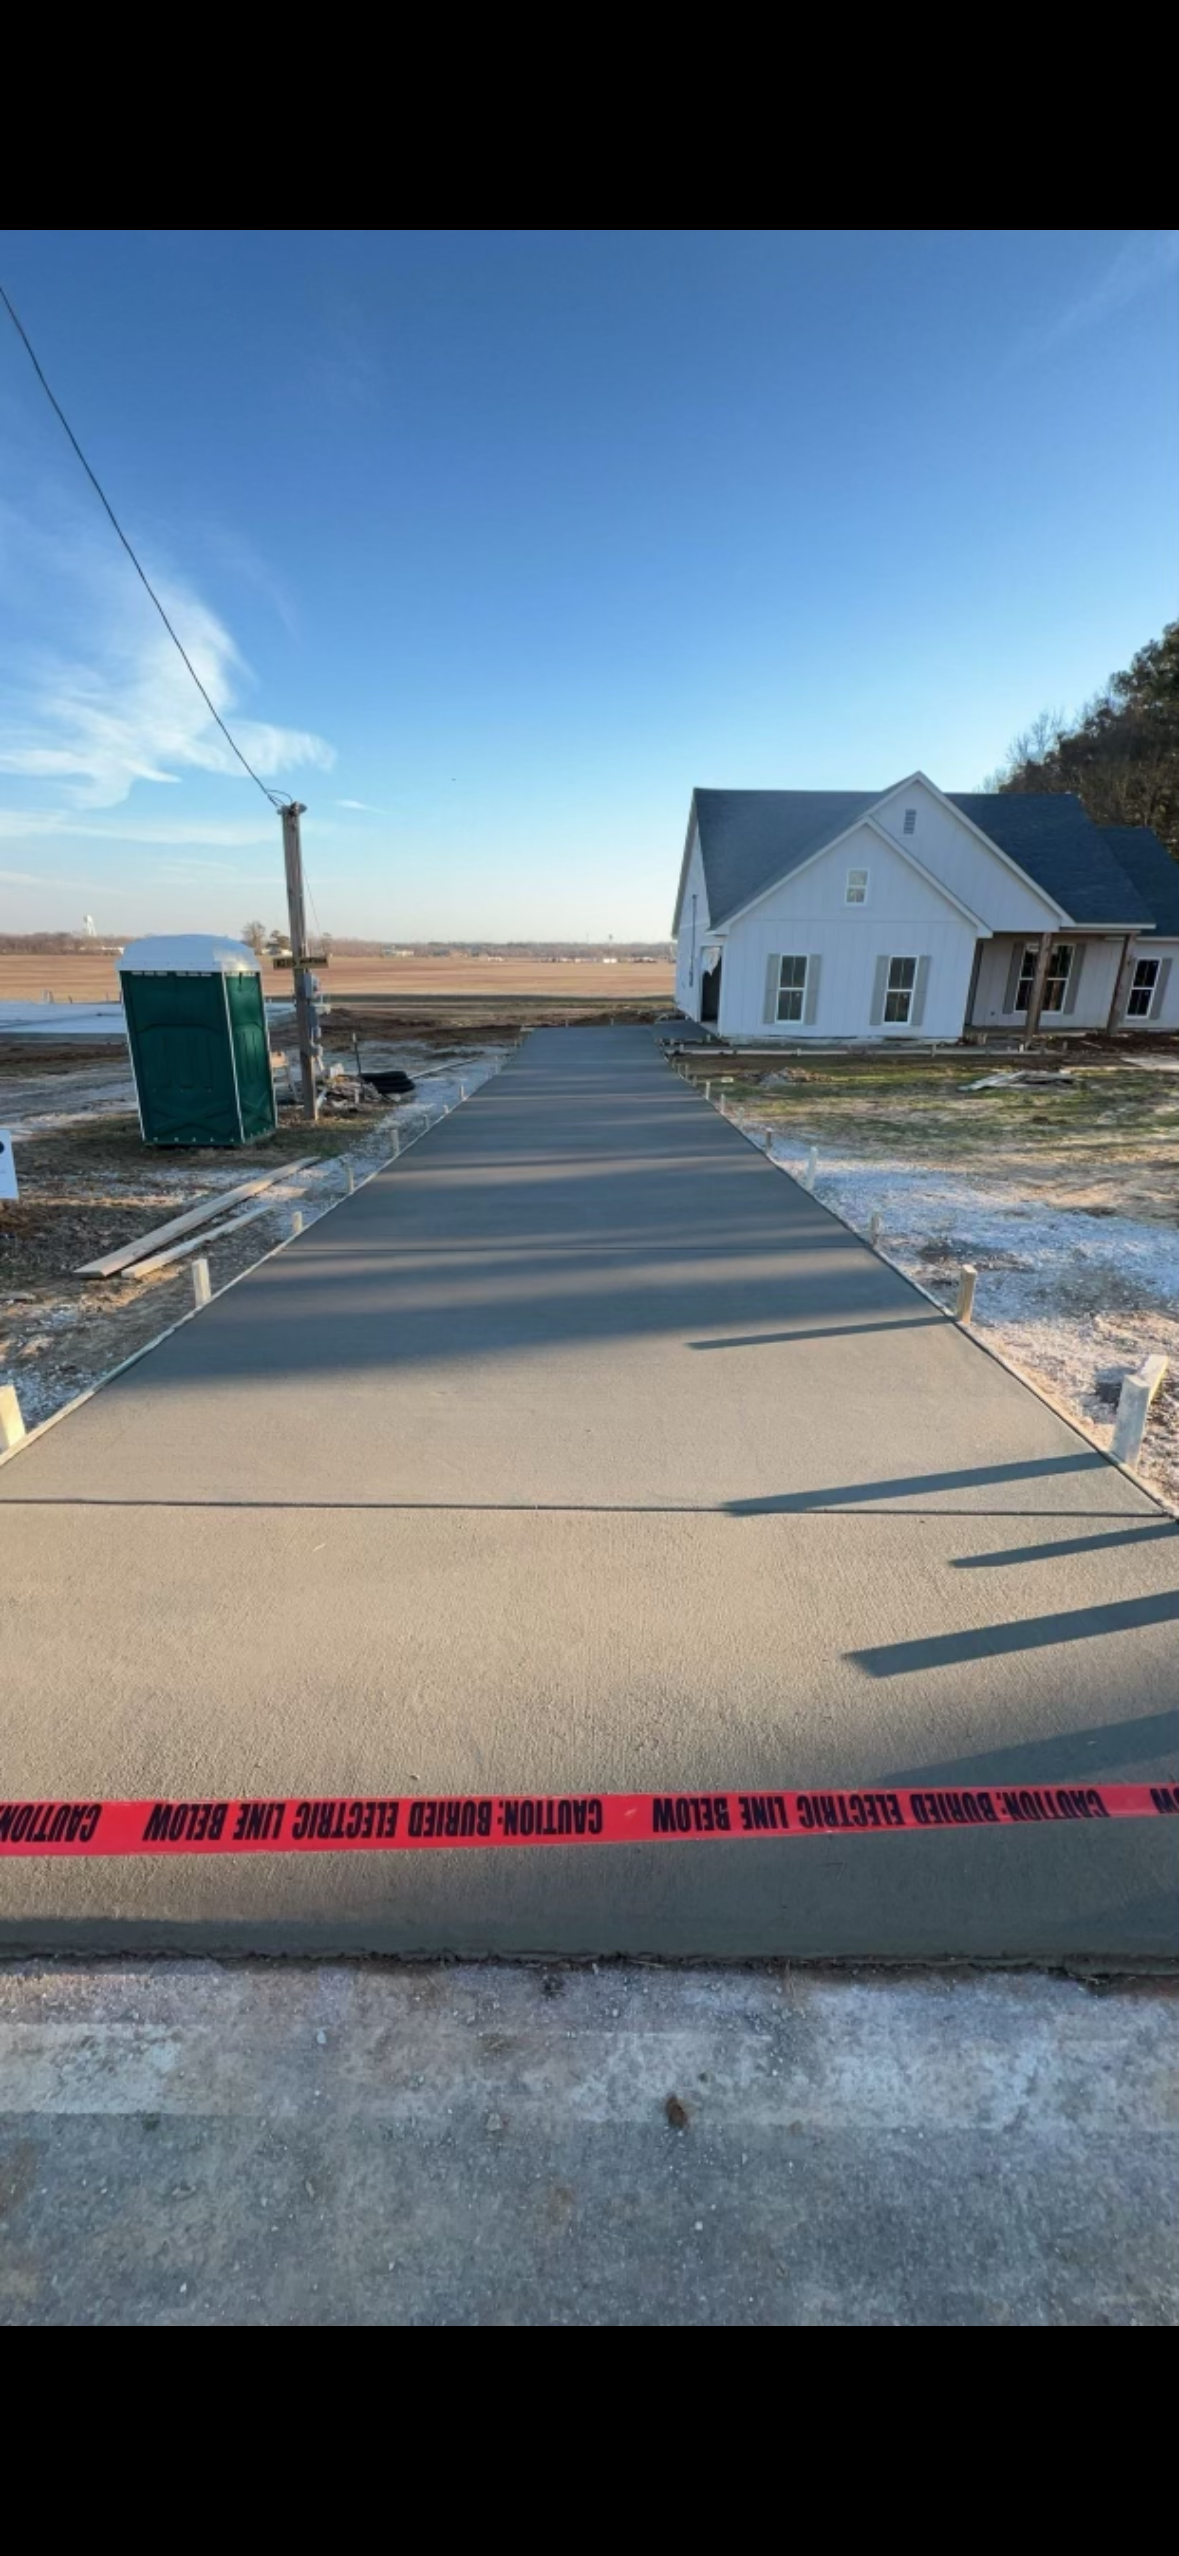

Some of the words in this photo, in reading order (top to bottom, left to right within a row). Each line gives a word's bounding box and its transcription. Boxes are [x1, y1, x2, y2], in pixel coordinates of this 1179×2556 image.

[142, 1803, 228, 1841] BELOW
[232, 1803, 286, 1841] LINE
[292, 1801, 399, 1839] ELECTRIC
[408, 1800, 492, 1837] BURIED
[498, 1798, 603, 1836] CAUTION:
[653, 1798, 731, 1832] BELOW
[738, 1796, 788, 1830] LINE
[797, 1794, 905, 1829] ELECTRIC
[909, 1792, 1000, 1825] BURIED
[996, 1788, 1111, 1822] CAUTION:
